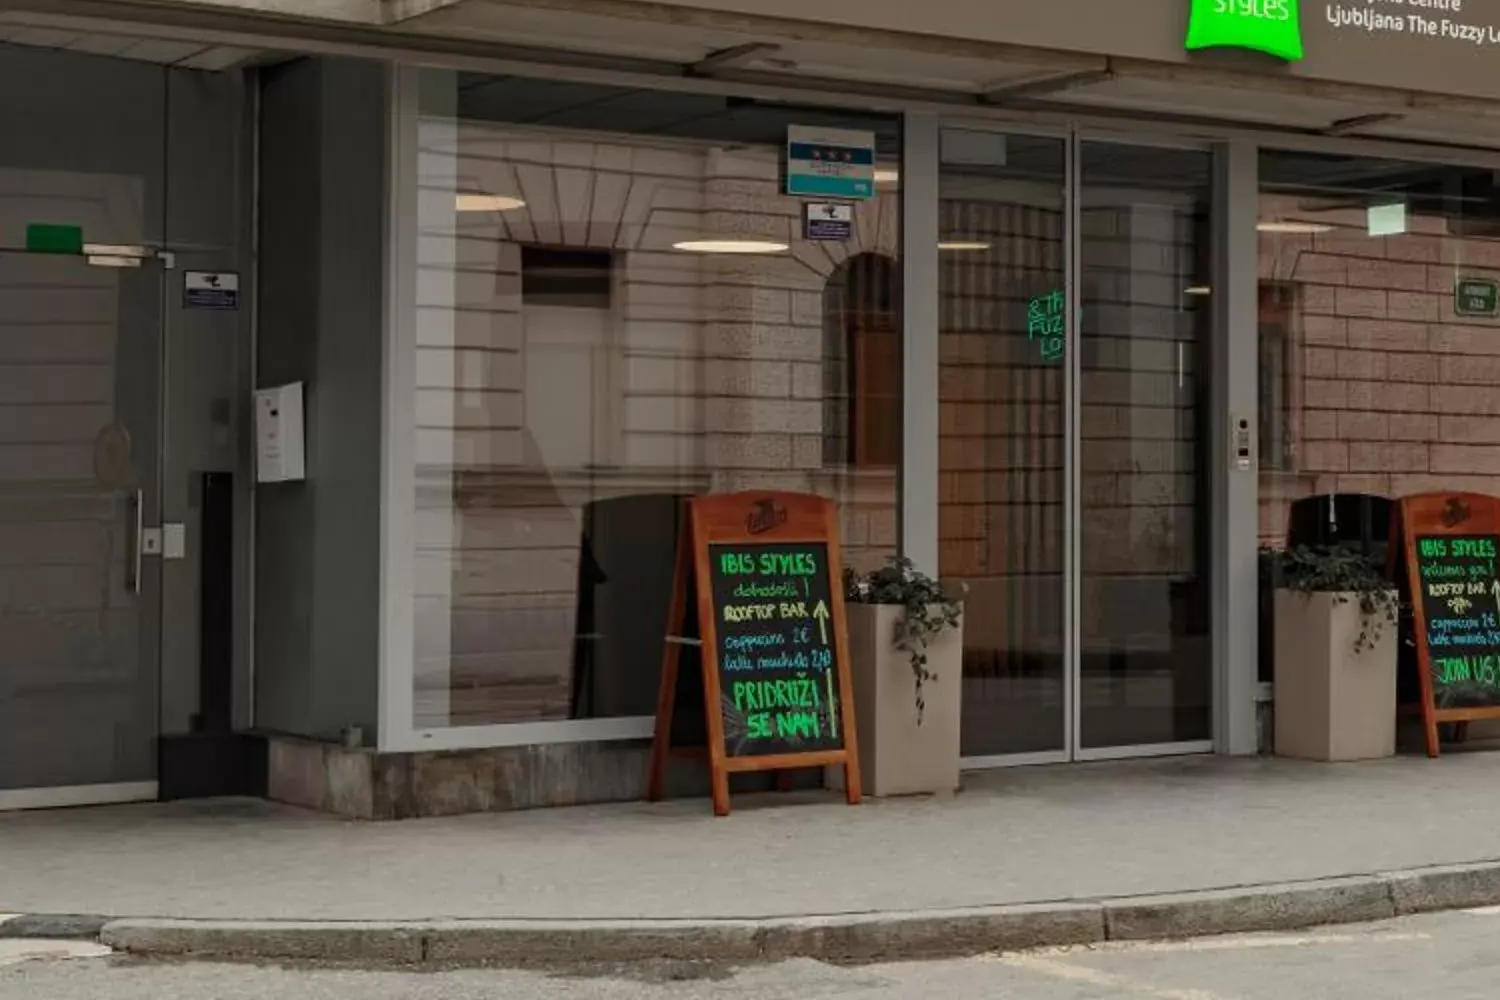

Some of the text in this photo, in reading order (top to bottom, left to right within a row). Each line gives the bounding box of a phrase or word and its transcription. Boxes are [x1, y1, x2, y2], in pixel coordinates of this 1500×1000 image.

[1326, 5, 1403, 35] Ljubljana
[1407, 12, 1437, 35] The
[1441, 18, 1484, 46] Fuzzy
[1451, 539, 1497, 558] STYLES
[720, 552, 816, 576] IBIS STYLES
[723, 602, 808, 622] ROOFTOP BAR
[1436, 656, 1469, 683] JOIN
[733, 672, 820, 711] PRIDRUŽI
[746, 711, 820, 738] SE NAM
